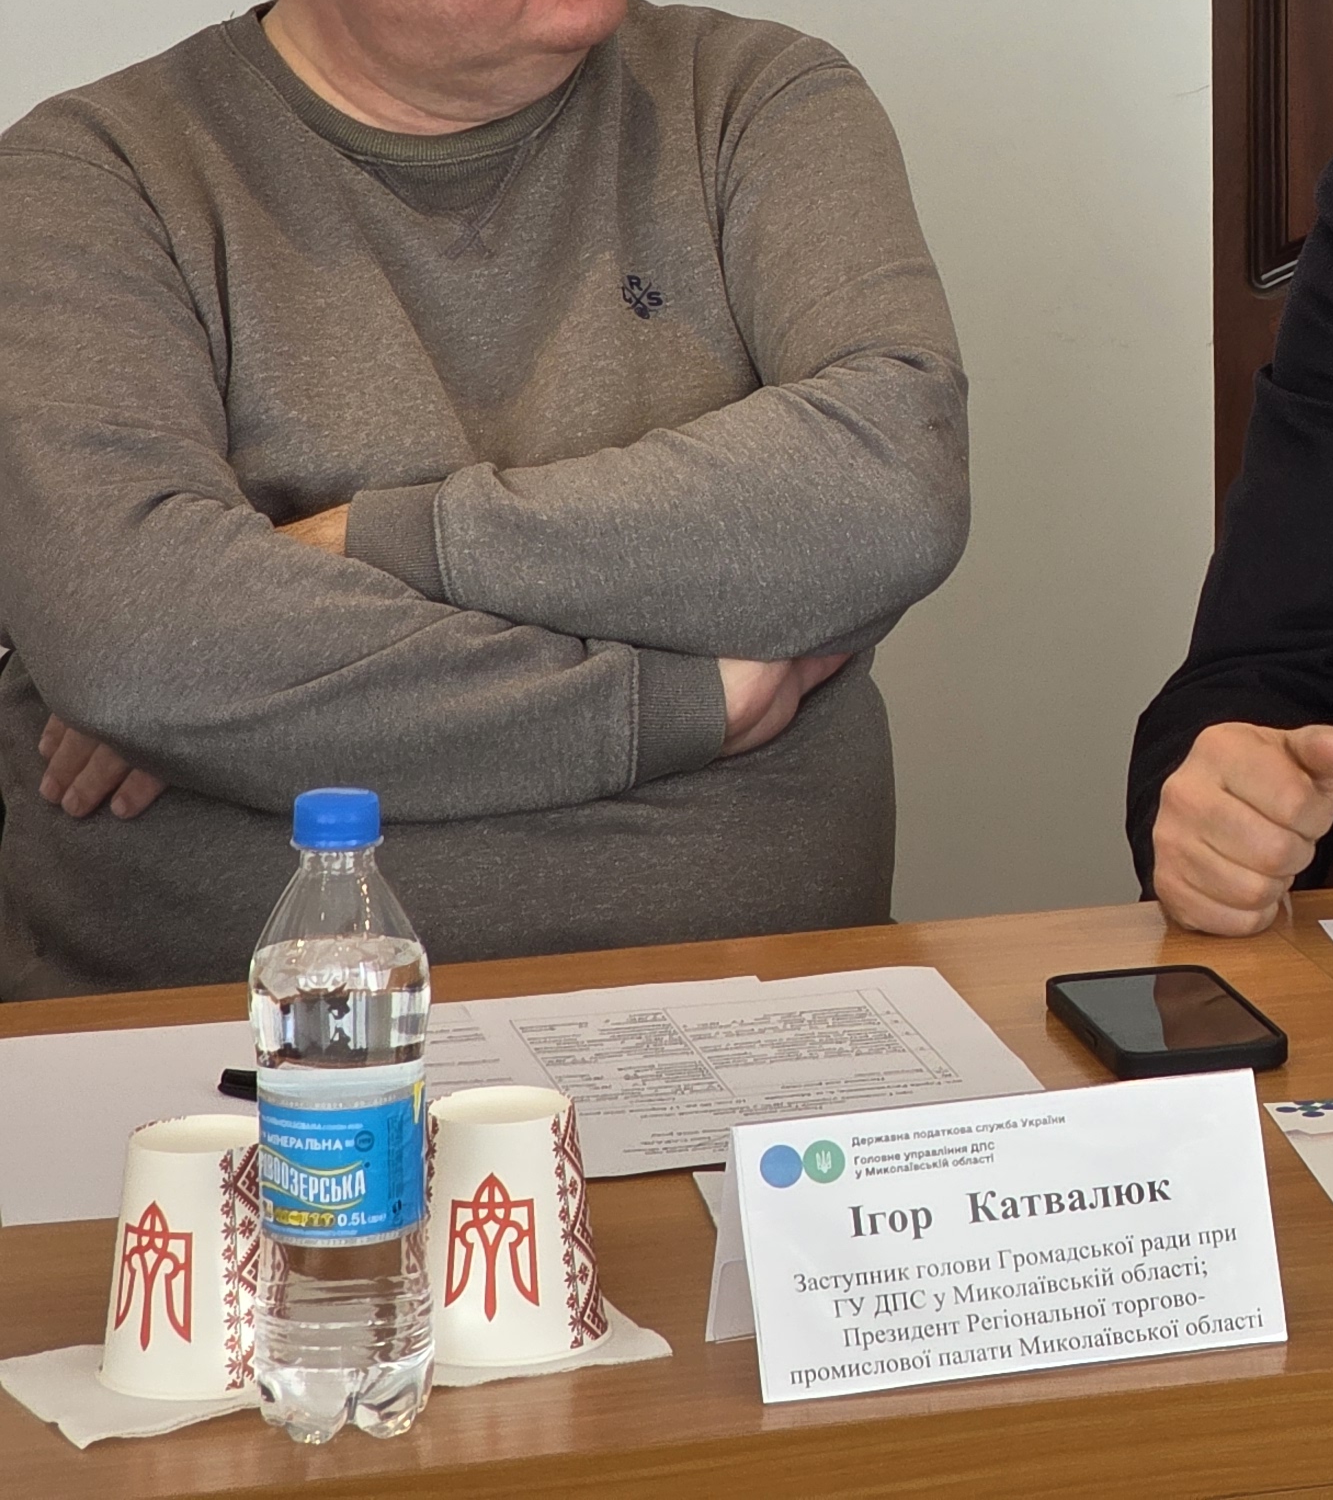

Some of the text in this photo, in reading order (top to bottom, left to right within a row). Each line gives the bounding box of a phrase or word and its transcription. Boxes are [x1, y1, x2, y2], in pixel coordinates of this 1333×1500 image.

[851, 1114, 1066, 1148] Державна податкова служба України
[853, 1141, 996, 1166] Головне управління ДПС
[865, 1157, 950, 1177] Миколаївській
[951, 1153, 995, 1167] області
[847, 1179, 1172, 1241] Ігор Катвалюк
[793, 1227, 1237, 1293] Заступник голови Громадської ради при
[833, 1255, 1208, 1319] ГУ ДПС у Миколаївській області;
[790, 1307, 1264, 1388] промислової палати Миколаївської області
[842, 1291, 1206, 1350] Президент Регіональної торгово-
